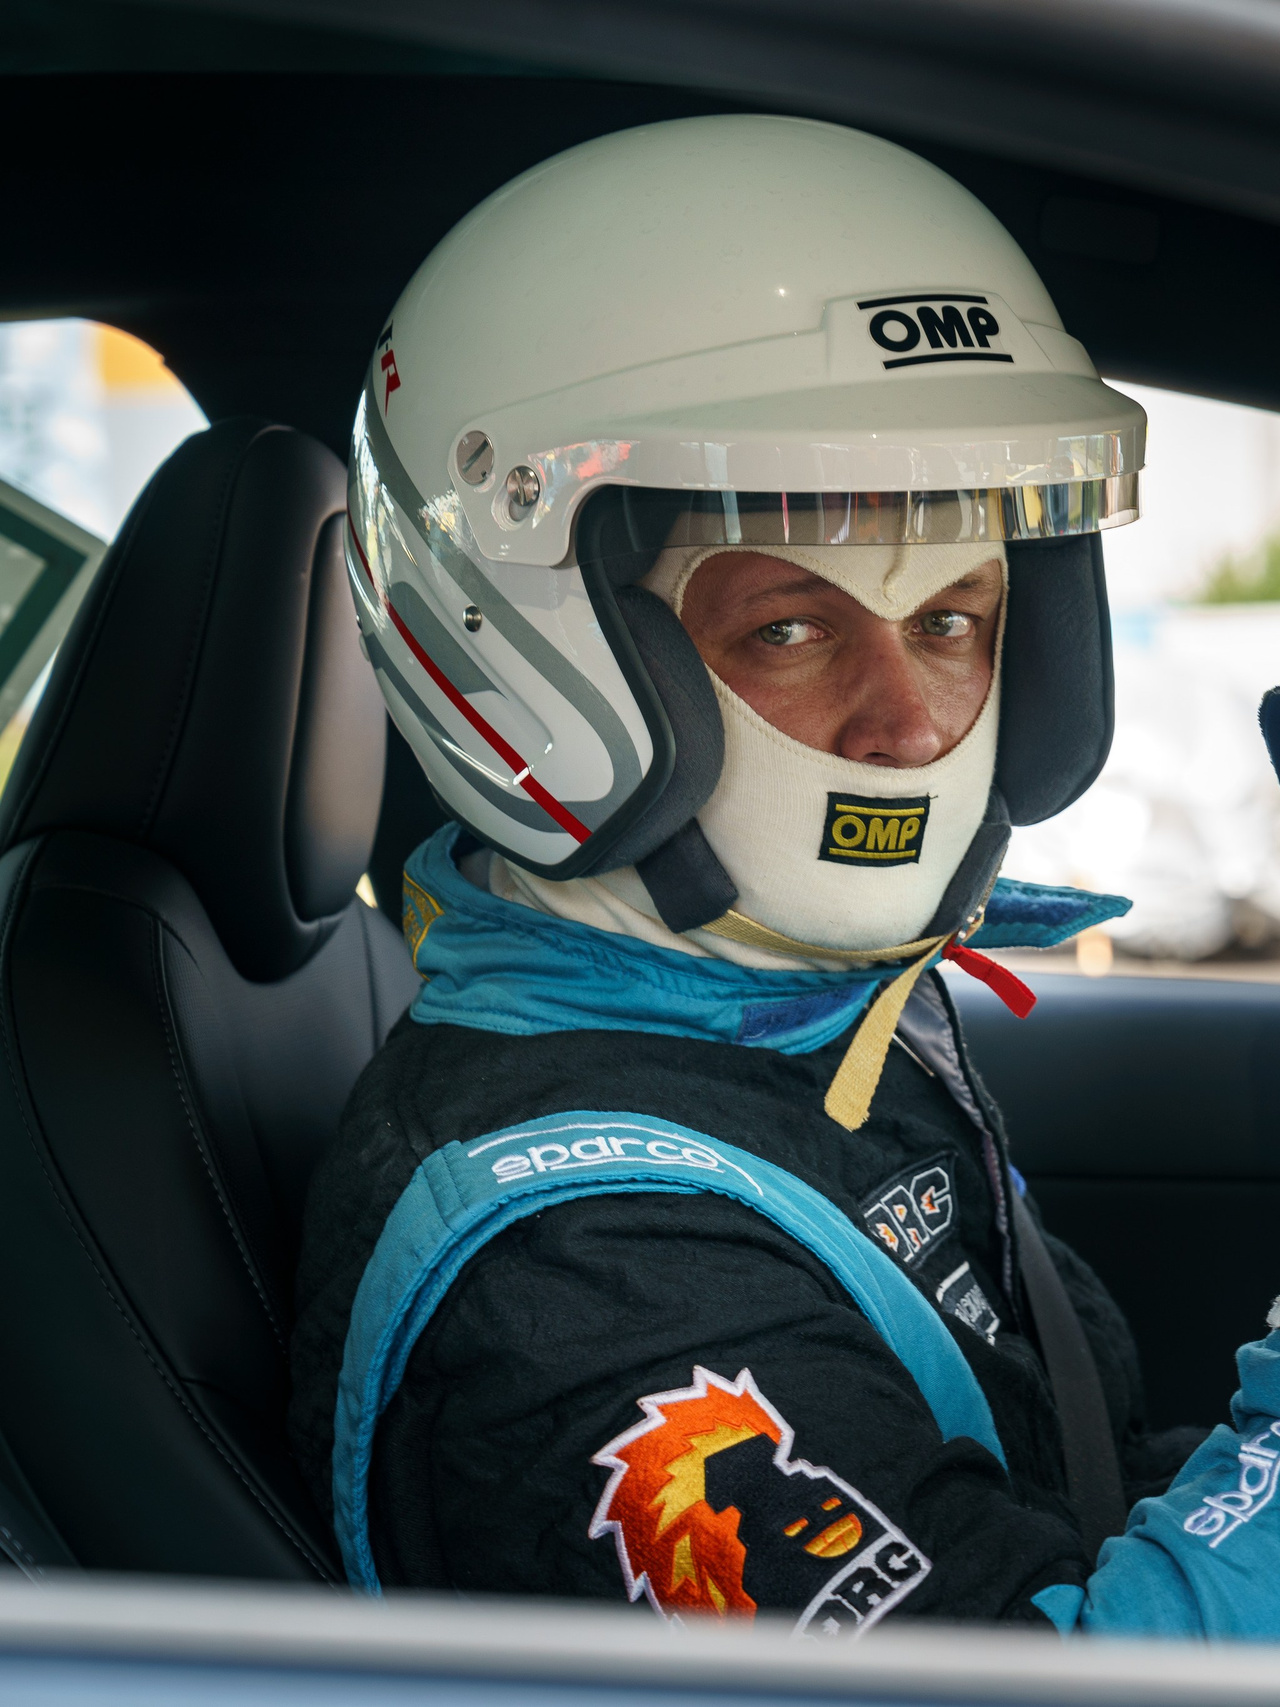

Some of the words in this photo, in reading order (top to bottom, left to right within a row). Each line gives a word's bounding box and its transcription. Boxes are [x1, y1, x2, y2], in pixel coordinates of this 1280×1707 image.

[869, 304, 1000, 352] OMP
[831, 814, 921, 851] OMP
[491, 1136, 719, 1178] sparco
